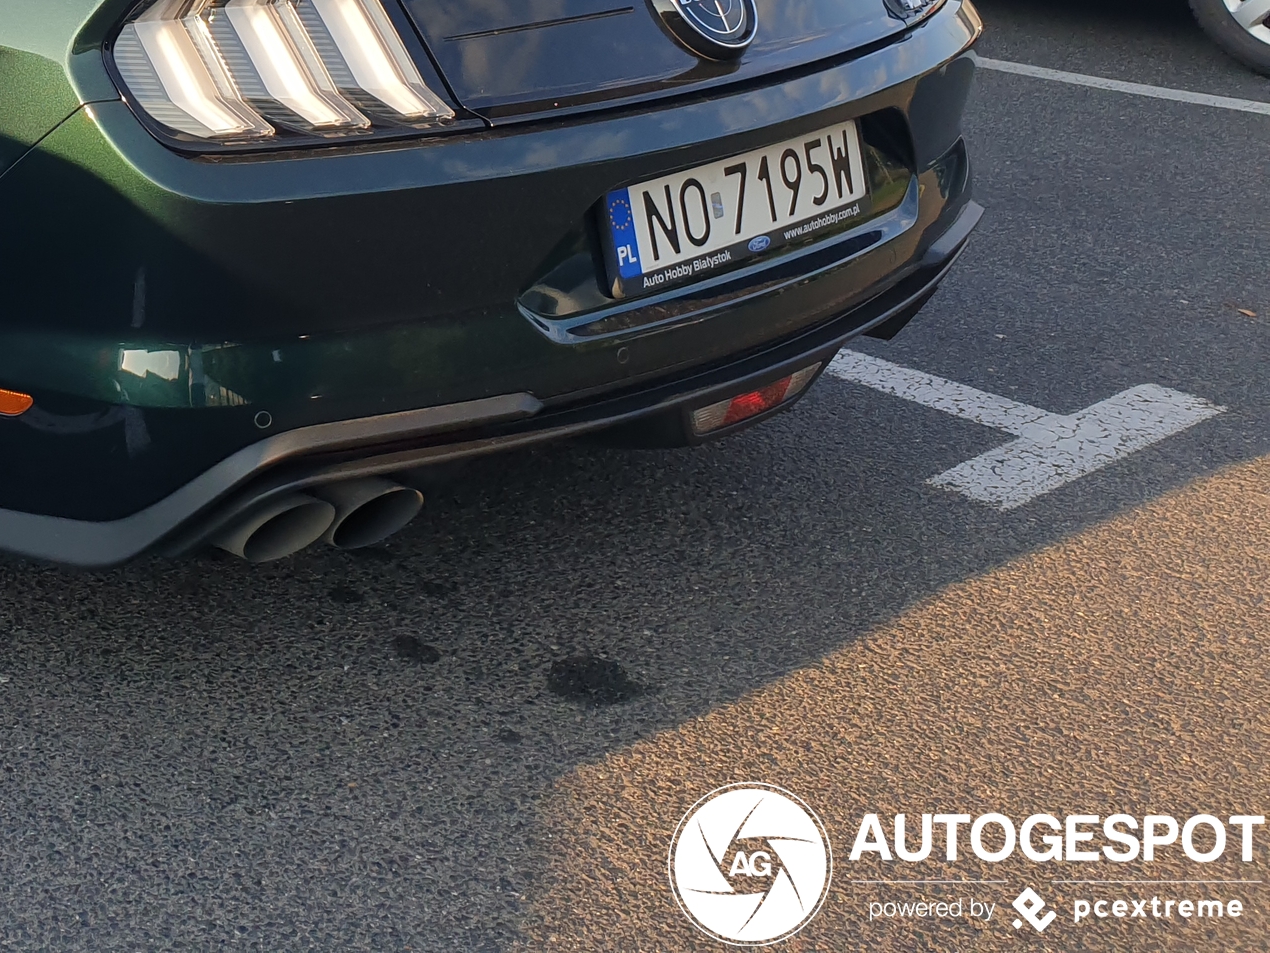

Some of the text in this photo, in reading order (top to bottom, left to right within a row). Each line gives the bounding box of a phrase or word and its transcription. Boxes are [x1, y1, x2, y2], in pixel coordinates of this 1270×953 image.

[642, 129, 854, 261] NO 7195W
[783, 203, 861, 240] www.autohobby.com.pl
[617, 244, 637, 266] PL
[643, 250, 732, 288] Auto Hobby Białystok
